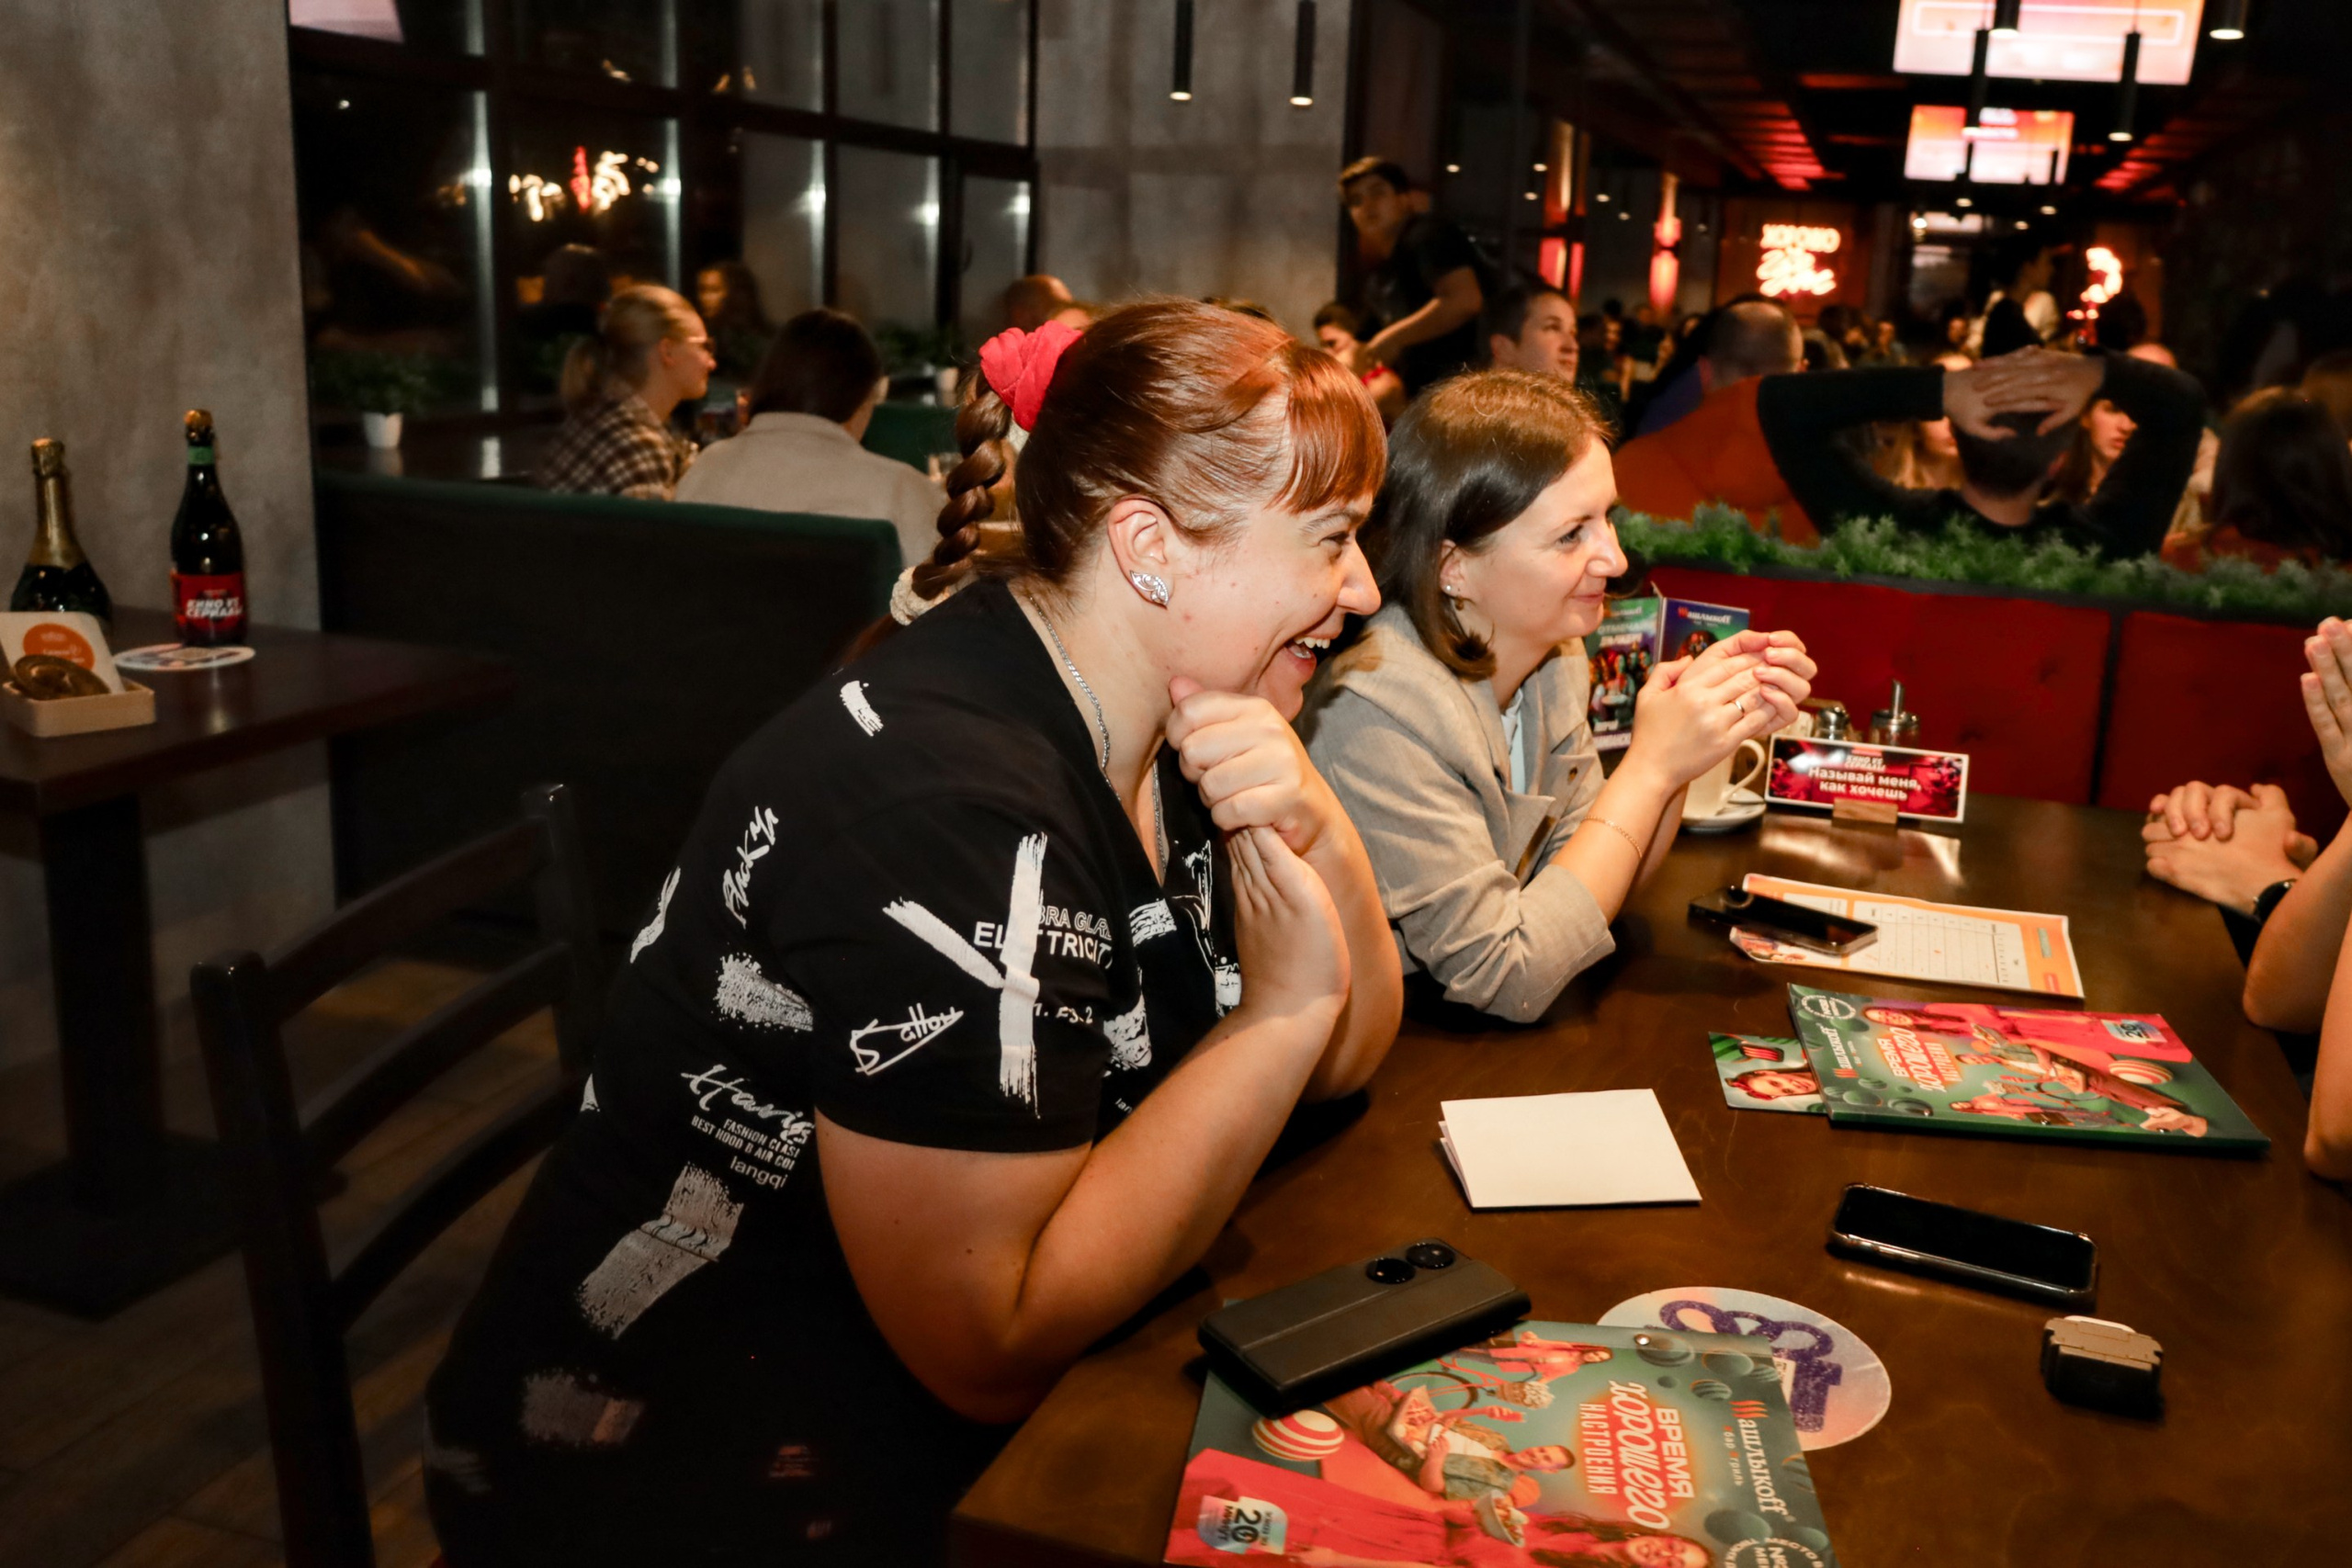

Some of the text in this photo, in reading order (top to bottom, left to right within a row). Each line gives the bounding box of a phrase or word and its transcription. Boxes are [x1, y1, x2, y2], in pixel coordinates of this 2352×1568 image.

[1808, 766, 1922, 791] Называй меня,
[1819, 781, 1908, 801] как хочешь
[1876, 1038, 1910, 1077] ВРЕМЯ
[691, 1114, 714, 1135] BEST
[754, 1145, 775, 1163] AIR
[723, 1118, 768, 1146] FASHION
[1578, 1403, 1619, 1495] НАСТРОЕНИЯ
[1655, 1407, 1696, 1498] ВРЕМЯ
[1724, 1430, 1745, 1487] бар гриль
[1232, 1509, 1261, 1543] 20
